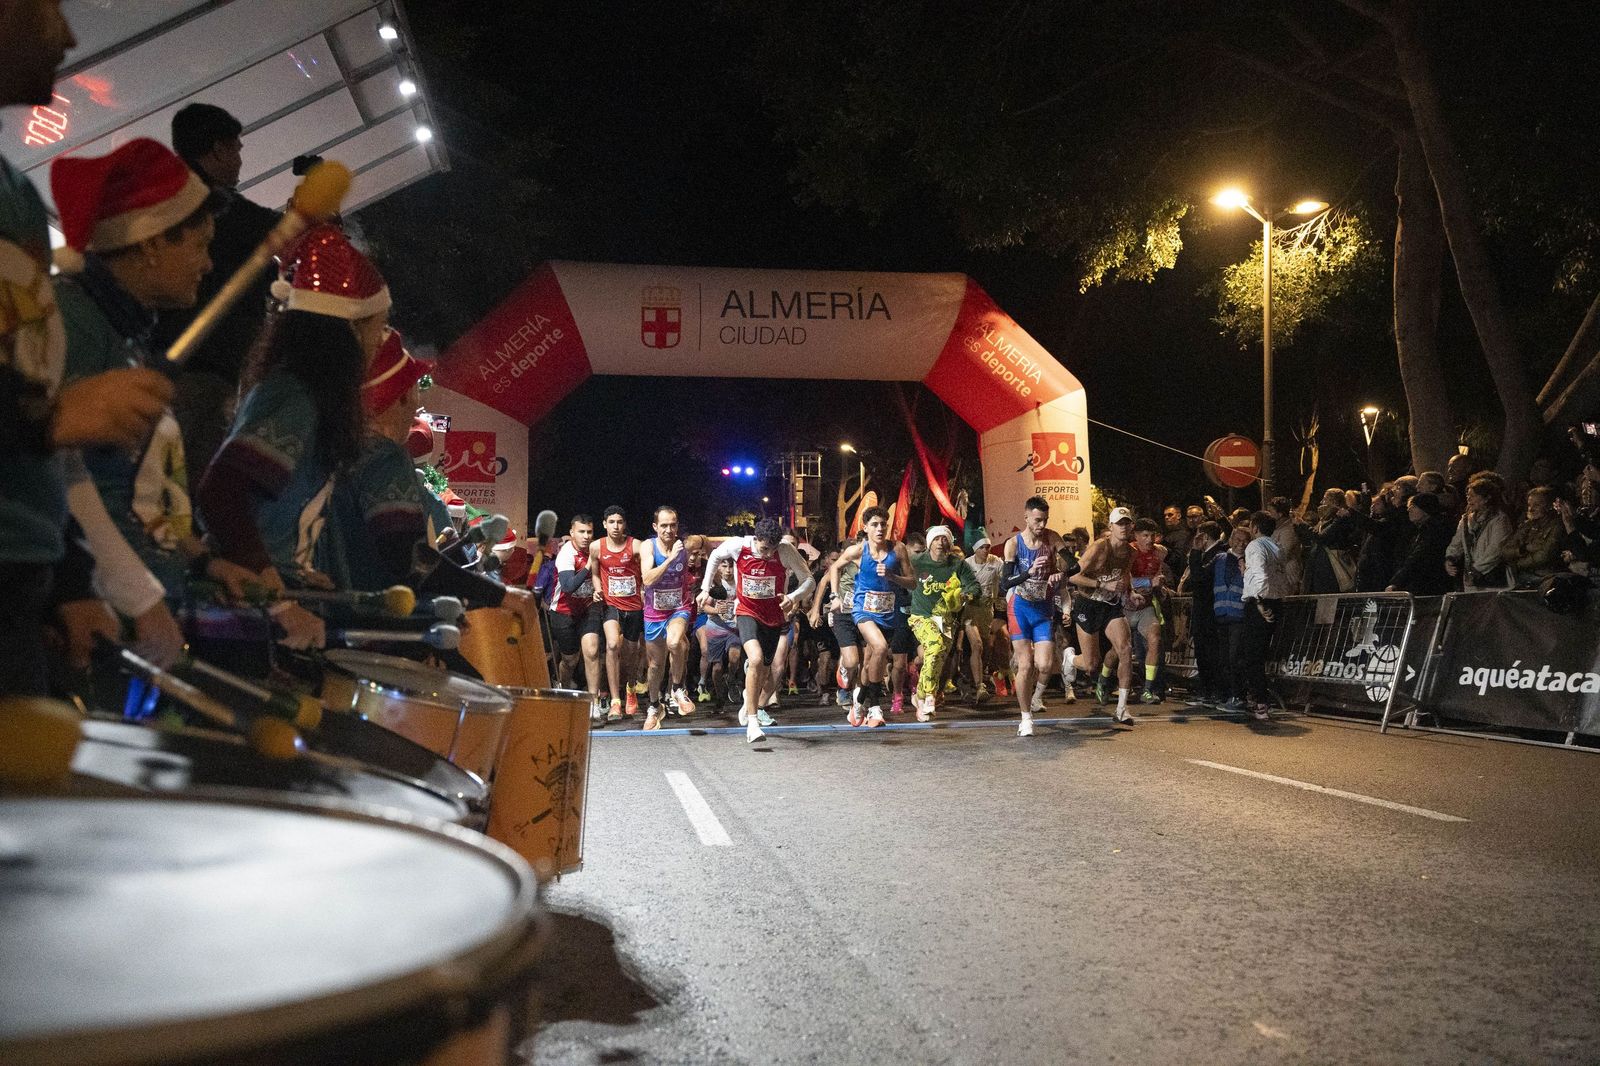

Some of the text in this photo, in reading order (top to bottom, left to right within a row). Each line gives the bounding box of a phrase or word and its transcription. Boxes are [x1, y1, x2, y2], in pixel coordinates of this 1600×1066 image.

[720, 287, 892, 321] ALMERÍA
[479, 314, 551, 381] ALMERÍA
[719, 325, 807, 346] CIUDAD
[975, 322, 1042, 385] ALMERÍA
[493, 328, 564, 393] es deporte
[963, 335, 1031, 397] es deporte
[452, 488, 496, 497] EPORTES
[1035, 486, 1079, 494] DEPORTES
